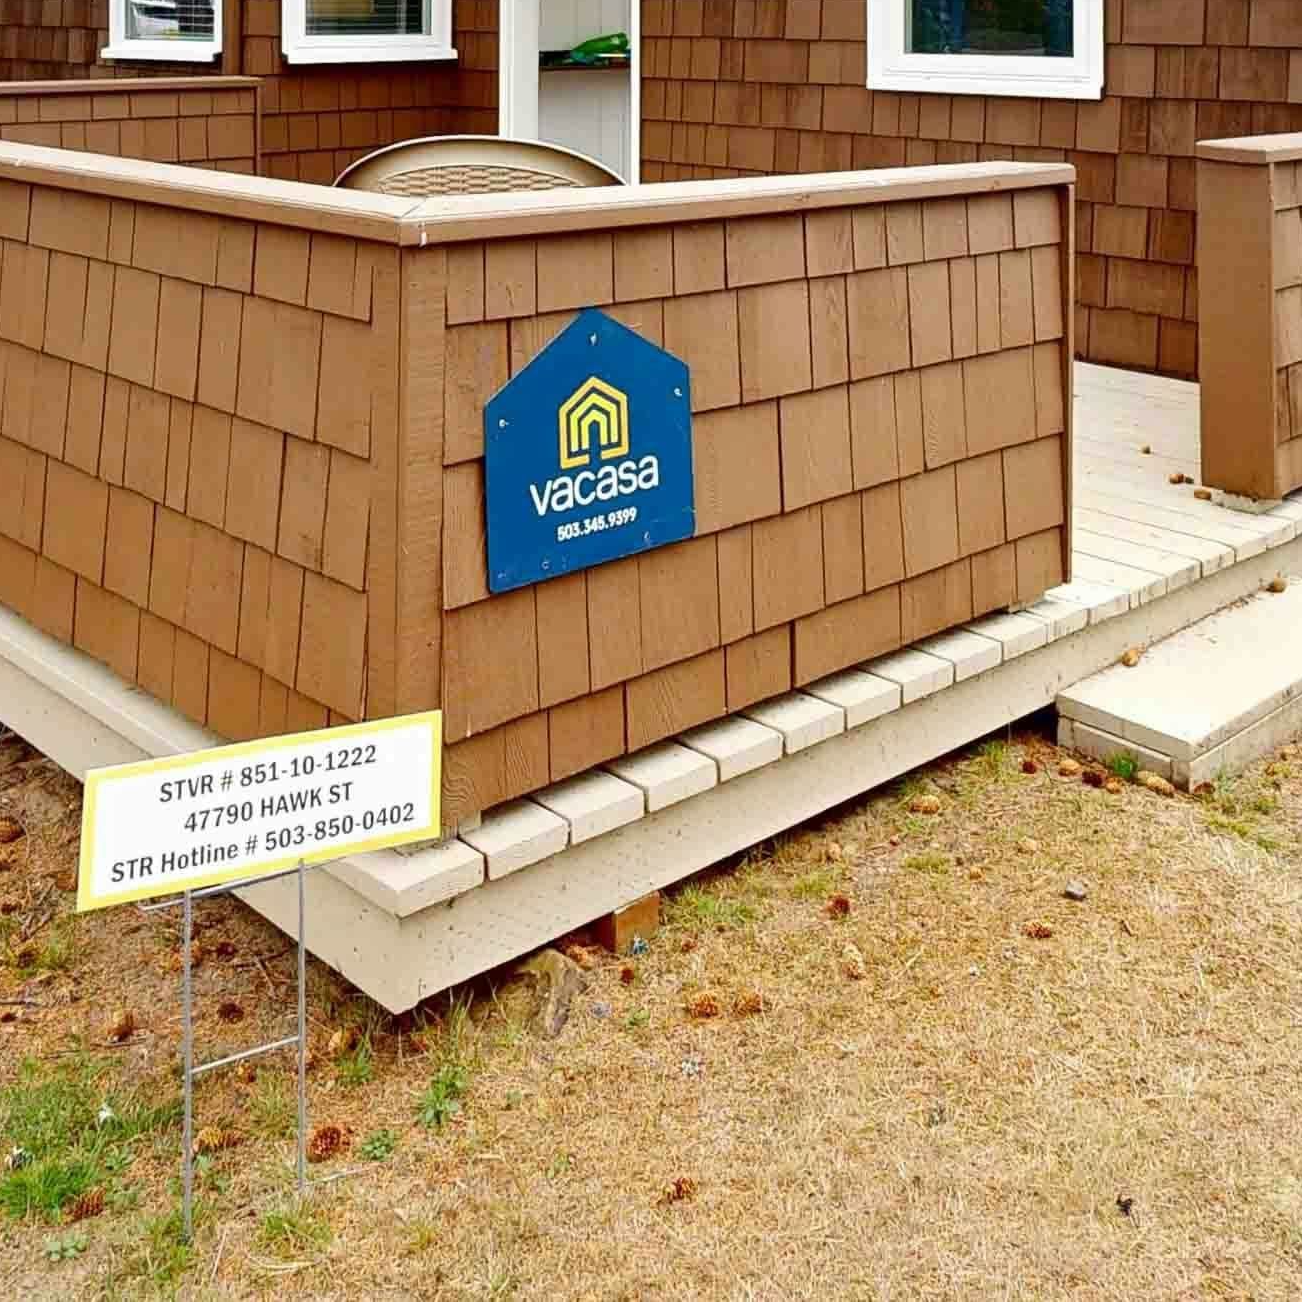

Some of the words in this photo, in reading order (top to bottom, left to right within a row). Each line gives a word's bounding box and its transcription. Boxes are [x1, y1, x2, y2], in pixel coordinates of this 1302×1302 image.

[529, 454, 659, 516] vacasa
[557, 507, 638, 542] 503.345.9399
[159, 774, 214, 804] STVR
[220, 773, 234, 792] #
[240, 745, 377, 788] 851-10-1222
[184, 801, 254, 833] 47790
[260, 787, 323, 819] HAWK
[328, 781, 354, 805] ST
[110, 856, 153, 883] STR
[160, 840, 239, 874] Hotline
[244, 835, 258, 856] #
[265, 802, 415, 853] 503-850-0402
